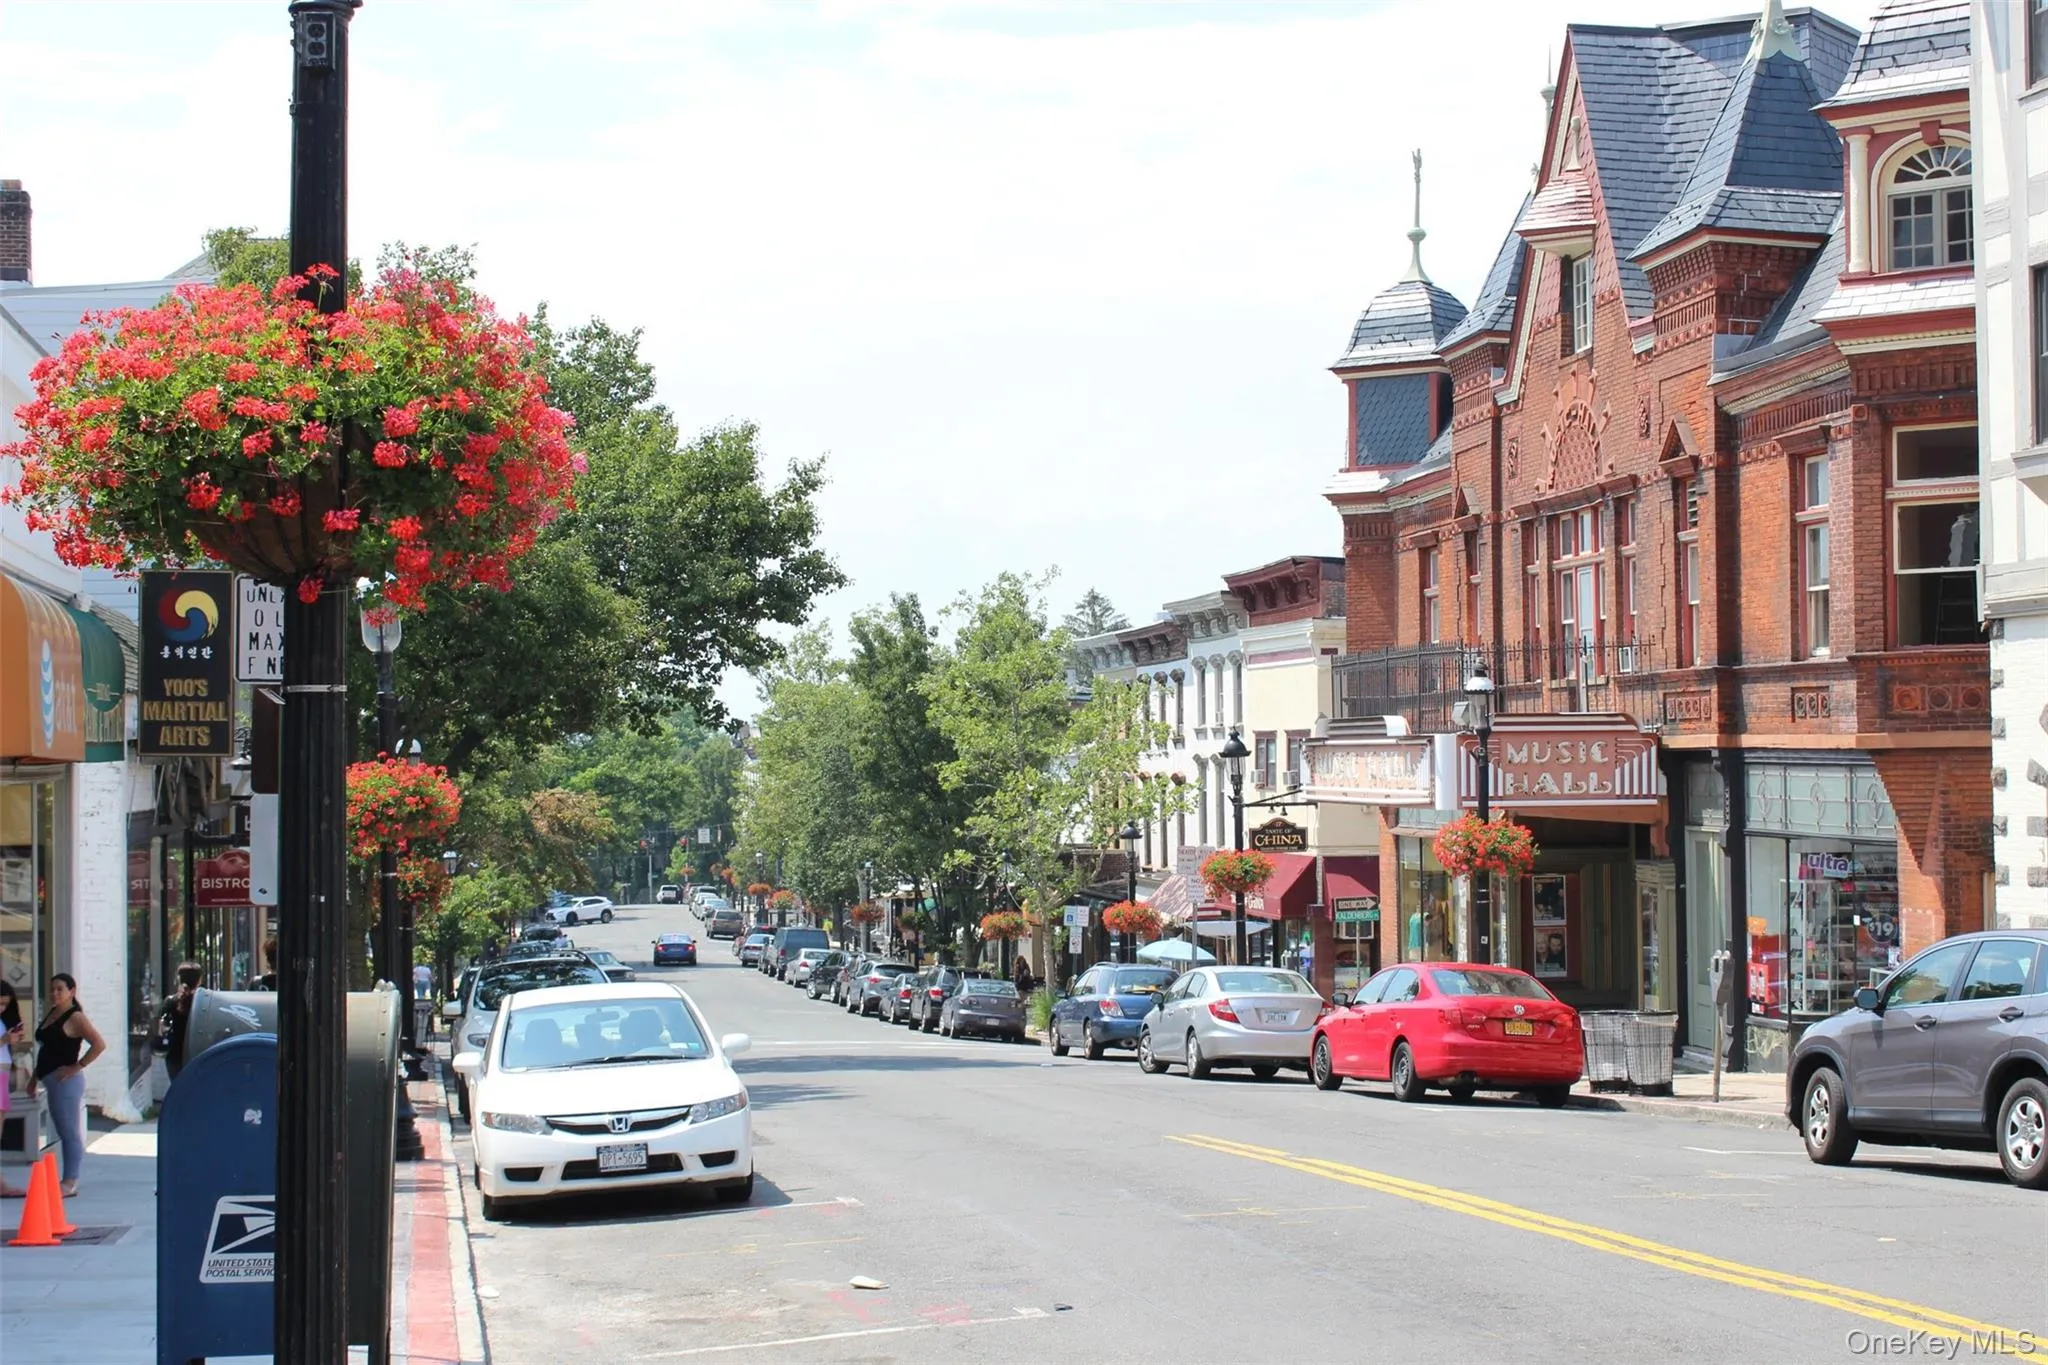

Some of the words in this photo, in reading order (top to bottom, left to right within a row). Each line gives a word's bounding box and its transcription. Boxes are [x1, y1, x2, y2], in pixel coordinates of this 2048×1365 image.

[163, 679, 209, 697] YOO'S
[143, 701, 229, 721] MARTIAL
[159, 726, 211, 746] ARTS
[1507, 741, 1609, 764] MUSIC
[1505, 771, 1612, 796] HALL
[1254, 834, 1303, 847] CHINA
[1807, 853, 1848, 872] ultra
[207, 1259, 244, 1267] UNITED
[246, 1258, 275, 1267] STATE
[205, 1269, 241, 1277] POSTAL
